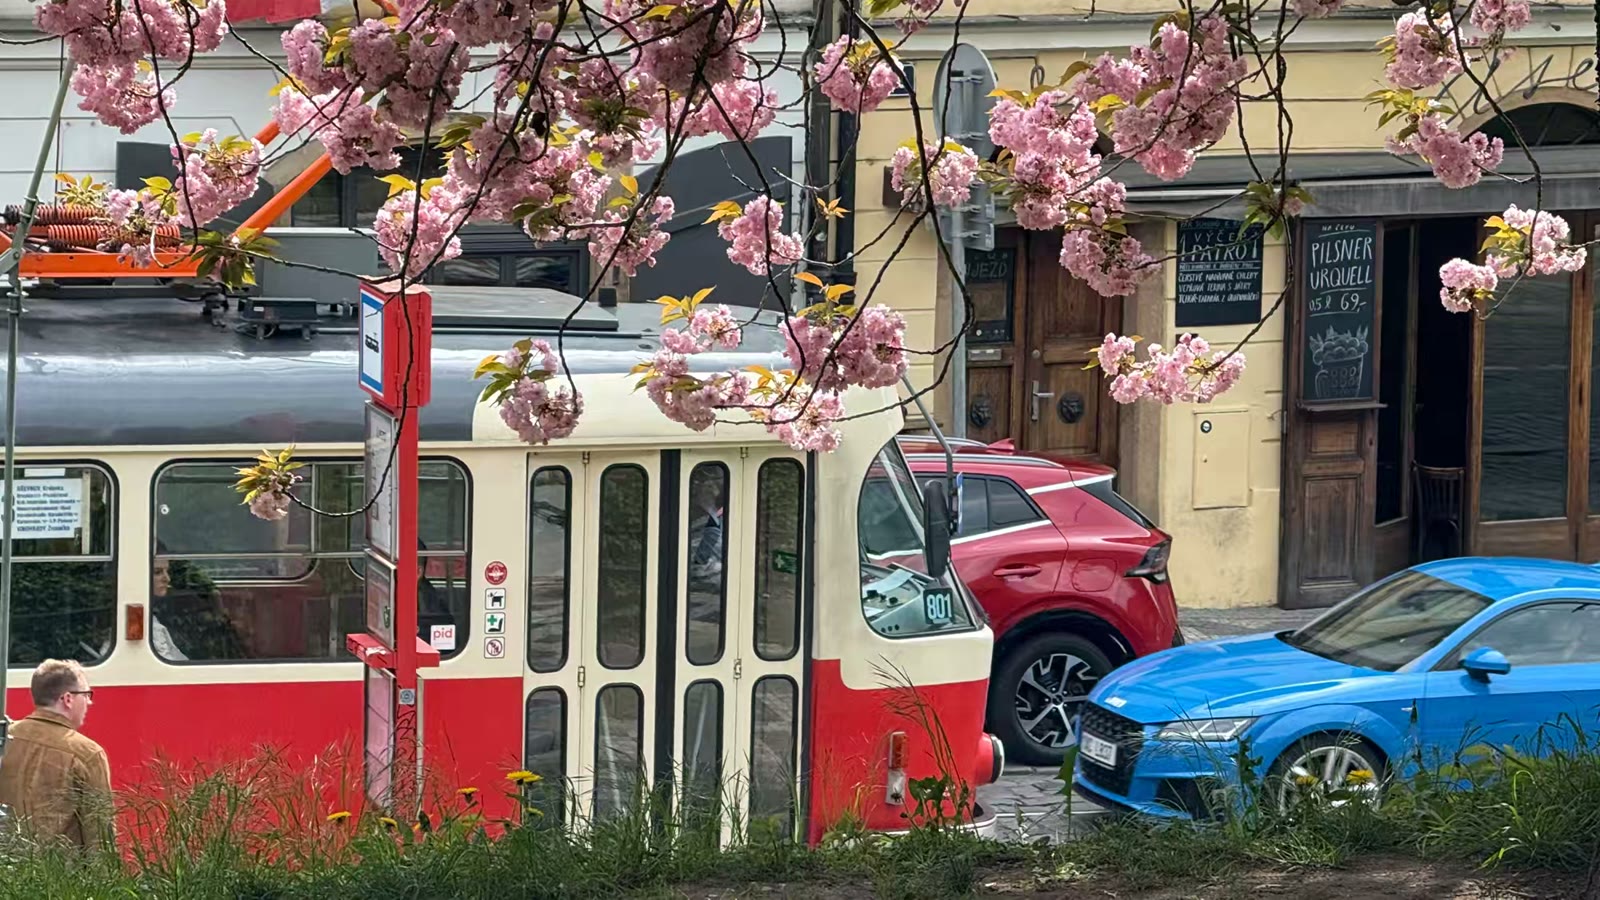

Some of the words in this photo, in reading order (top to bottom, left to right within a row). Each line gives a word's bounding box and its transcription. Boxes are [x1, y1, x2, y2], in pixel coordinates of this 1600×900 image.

[1311, 236, 1372, 268] PILSNER
[1310, 265, 1372, 290] URQUELL
[926, 593, 952, 620] 801
[433, 627, 453, 641] pid
